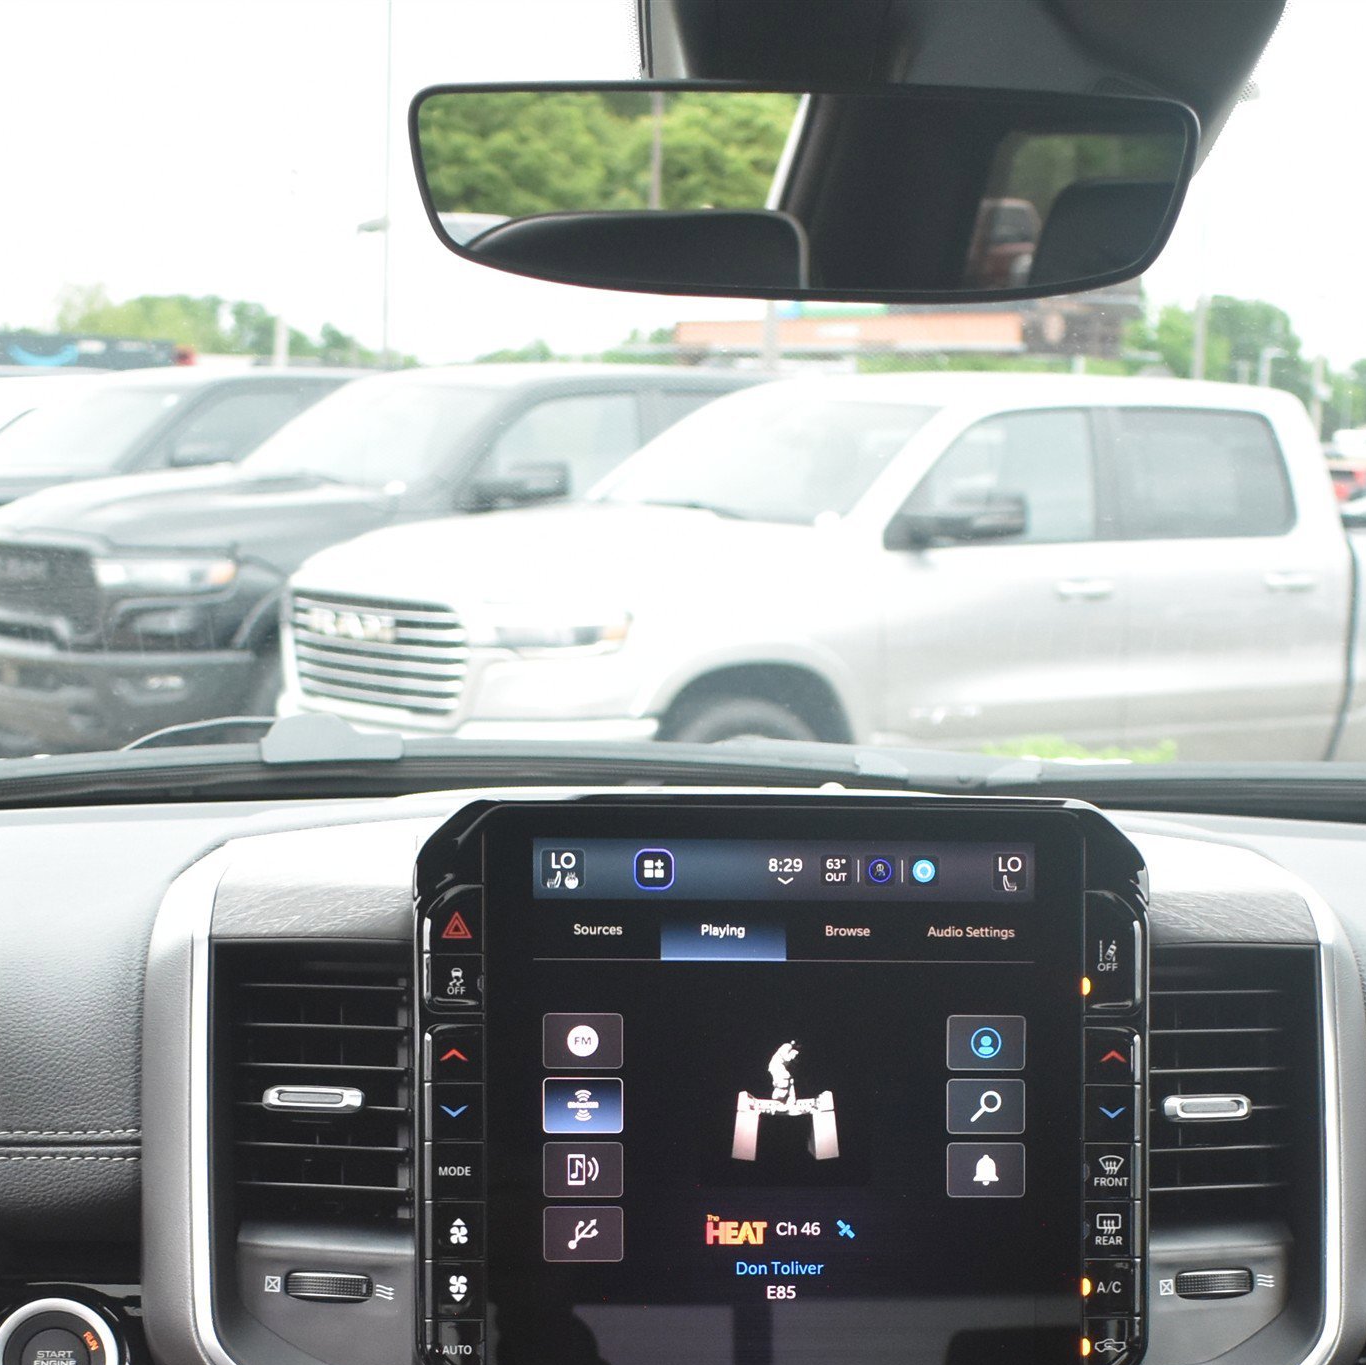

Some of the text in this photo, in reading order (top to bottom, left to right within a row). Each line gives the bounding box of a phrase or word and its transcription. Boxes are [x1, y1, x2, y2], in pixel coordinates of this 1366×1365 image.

[551, 852, 576, 869] LO
[768, 858, 803, 873] 8:29
[825, 858, 846, 870] 63°
[998, 857, 1023, 873] LO
[825, 872, 847, 882] OUT
[573, 923, 623, 935] Sources
[700, 923, 746, 938] Playing
[825, 925, 871, 937] Browse
[927, 926, 1015, 940] Audio Settings
[1097, 962, 1118, 971] OFF
[446, 986, 466, 995] OFF
[574, 1036, 592, 1045] FM
[438, 1166, 471, 1176] MODE
[1093, 1177, 1128, 1187] FRONT
[706, 1221, 821, 1245] HEAT Ch 46
[1095, 1235, 1123, 1246] REAR
[736, 1260, 824, 1275] Don Toliver
[766, 1285, 796, 1299] E85
[1096, 1281, 1122, 1294] A/C
[83, 1331, 99, 1351] RUN
[36, 1350, 73, 1358] START
[442, 1345, 472, 1355] AUTO
